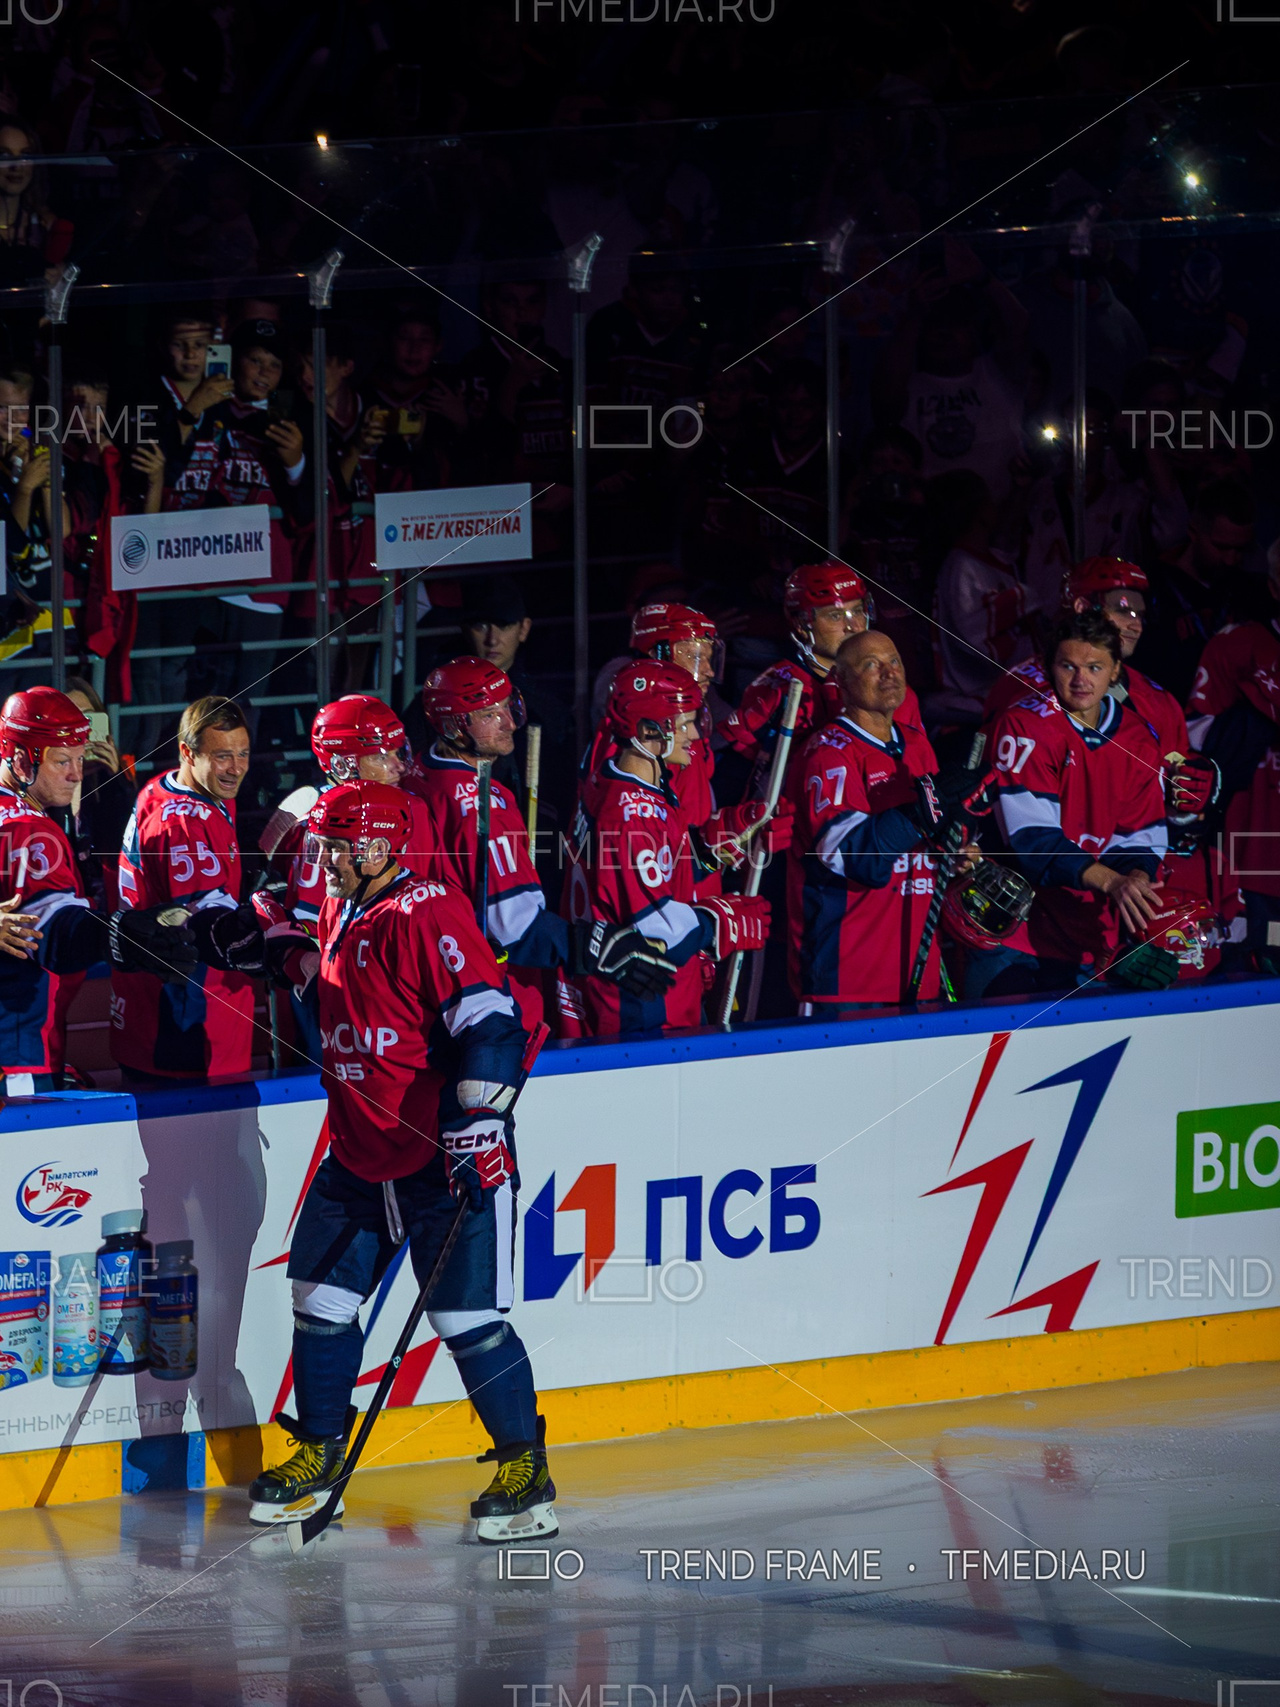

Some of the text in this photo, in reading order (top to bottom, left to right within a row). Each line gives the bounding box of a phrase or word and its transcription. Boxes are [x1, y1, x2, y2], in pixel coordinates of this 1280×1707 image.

[157, 530, 265, 559] ГАЗПРОМБАНК
[401, 516, 522, 542] T.ME/KRSCHINA
[996, 734, 1036, 774] 97
[807, 765, 847, 815] 27
[161, 802, 212, 822] FON
[460, 796, 507, 817] FN
[623, 802, 668, 823] FON
[169, 841, 222, 883] 55
[488, 835, 518, 877] 11
[635, 844, 672, 888] 69
[402, 882, 447, 914] FON
[438, 934, 466, 973] 8
[443, 1129, 498, 1151] CCM
[646, 1163, 821, 1267] ПСБ
[78, 1397, 205, 1427] СРЕДСТВОМ
